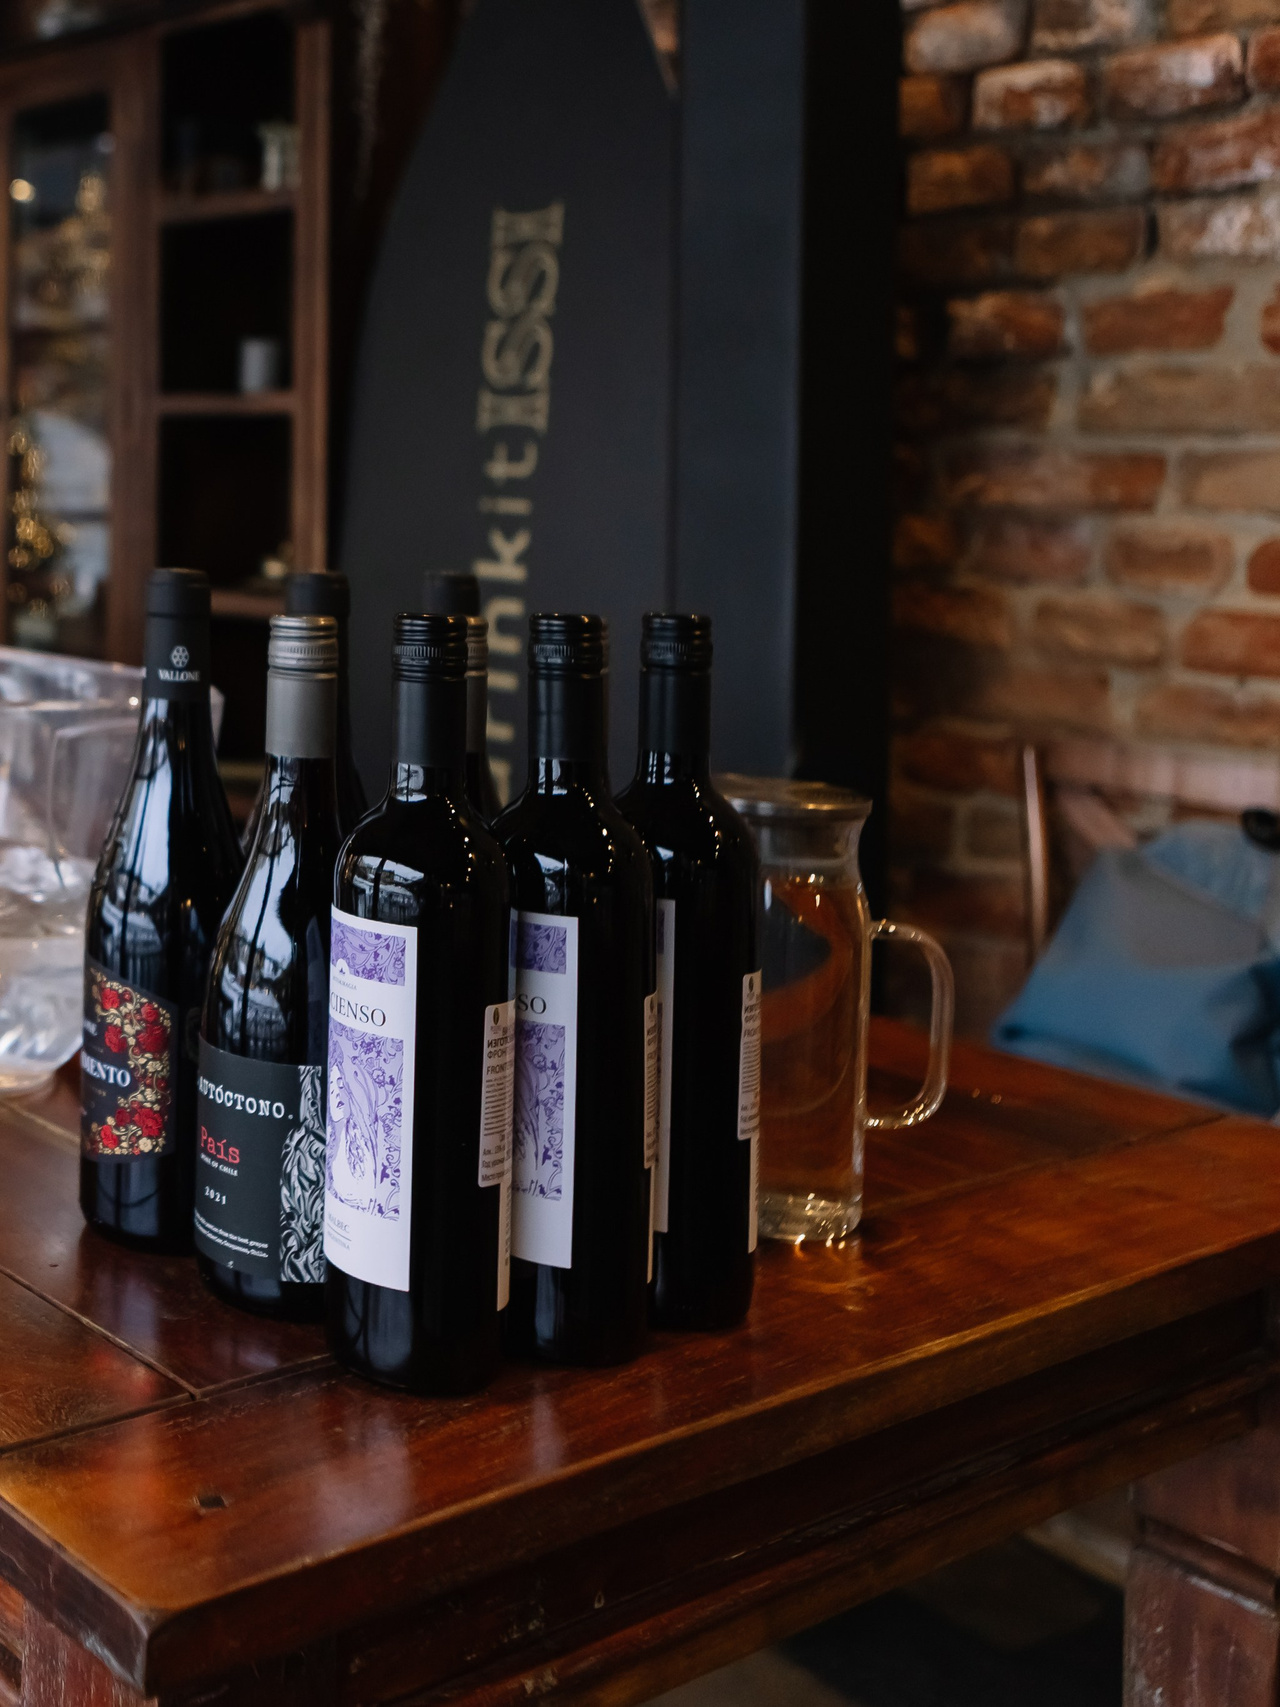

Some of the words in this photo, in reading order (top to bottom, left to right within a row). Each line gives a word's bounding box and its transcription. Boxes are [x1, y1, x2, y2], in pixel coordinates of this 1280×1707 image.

[158, 669, 200, 681] VALLONE
[200, 1125, 240, 1164] País
[204, 1185, 227, 1205] 2021
